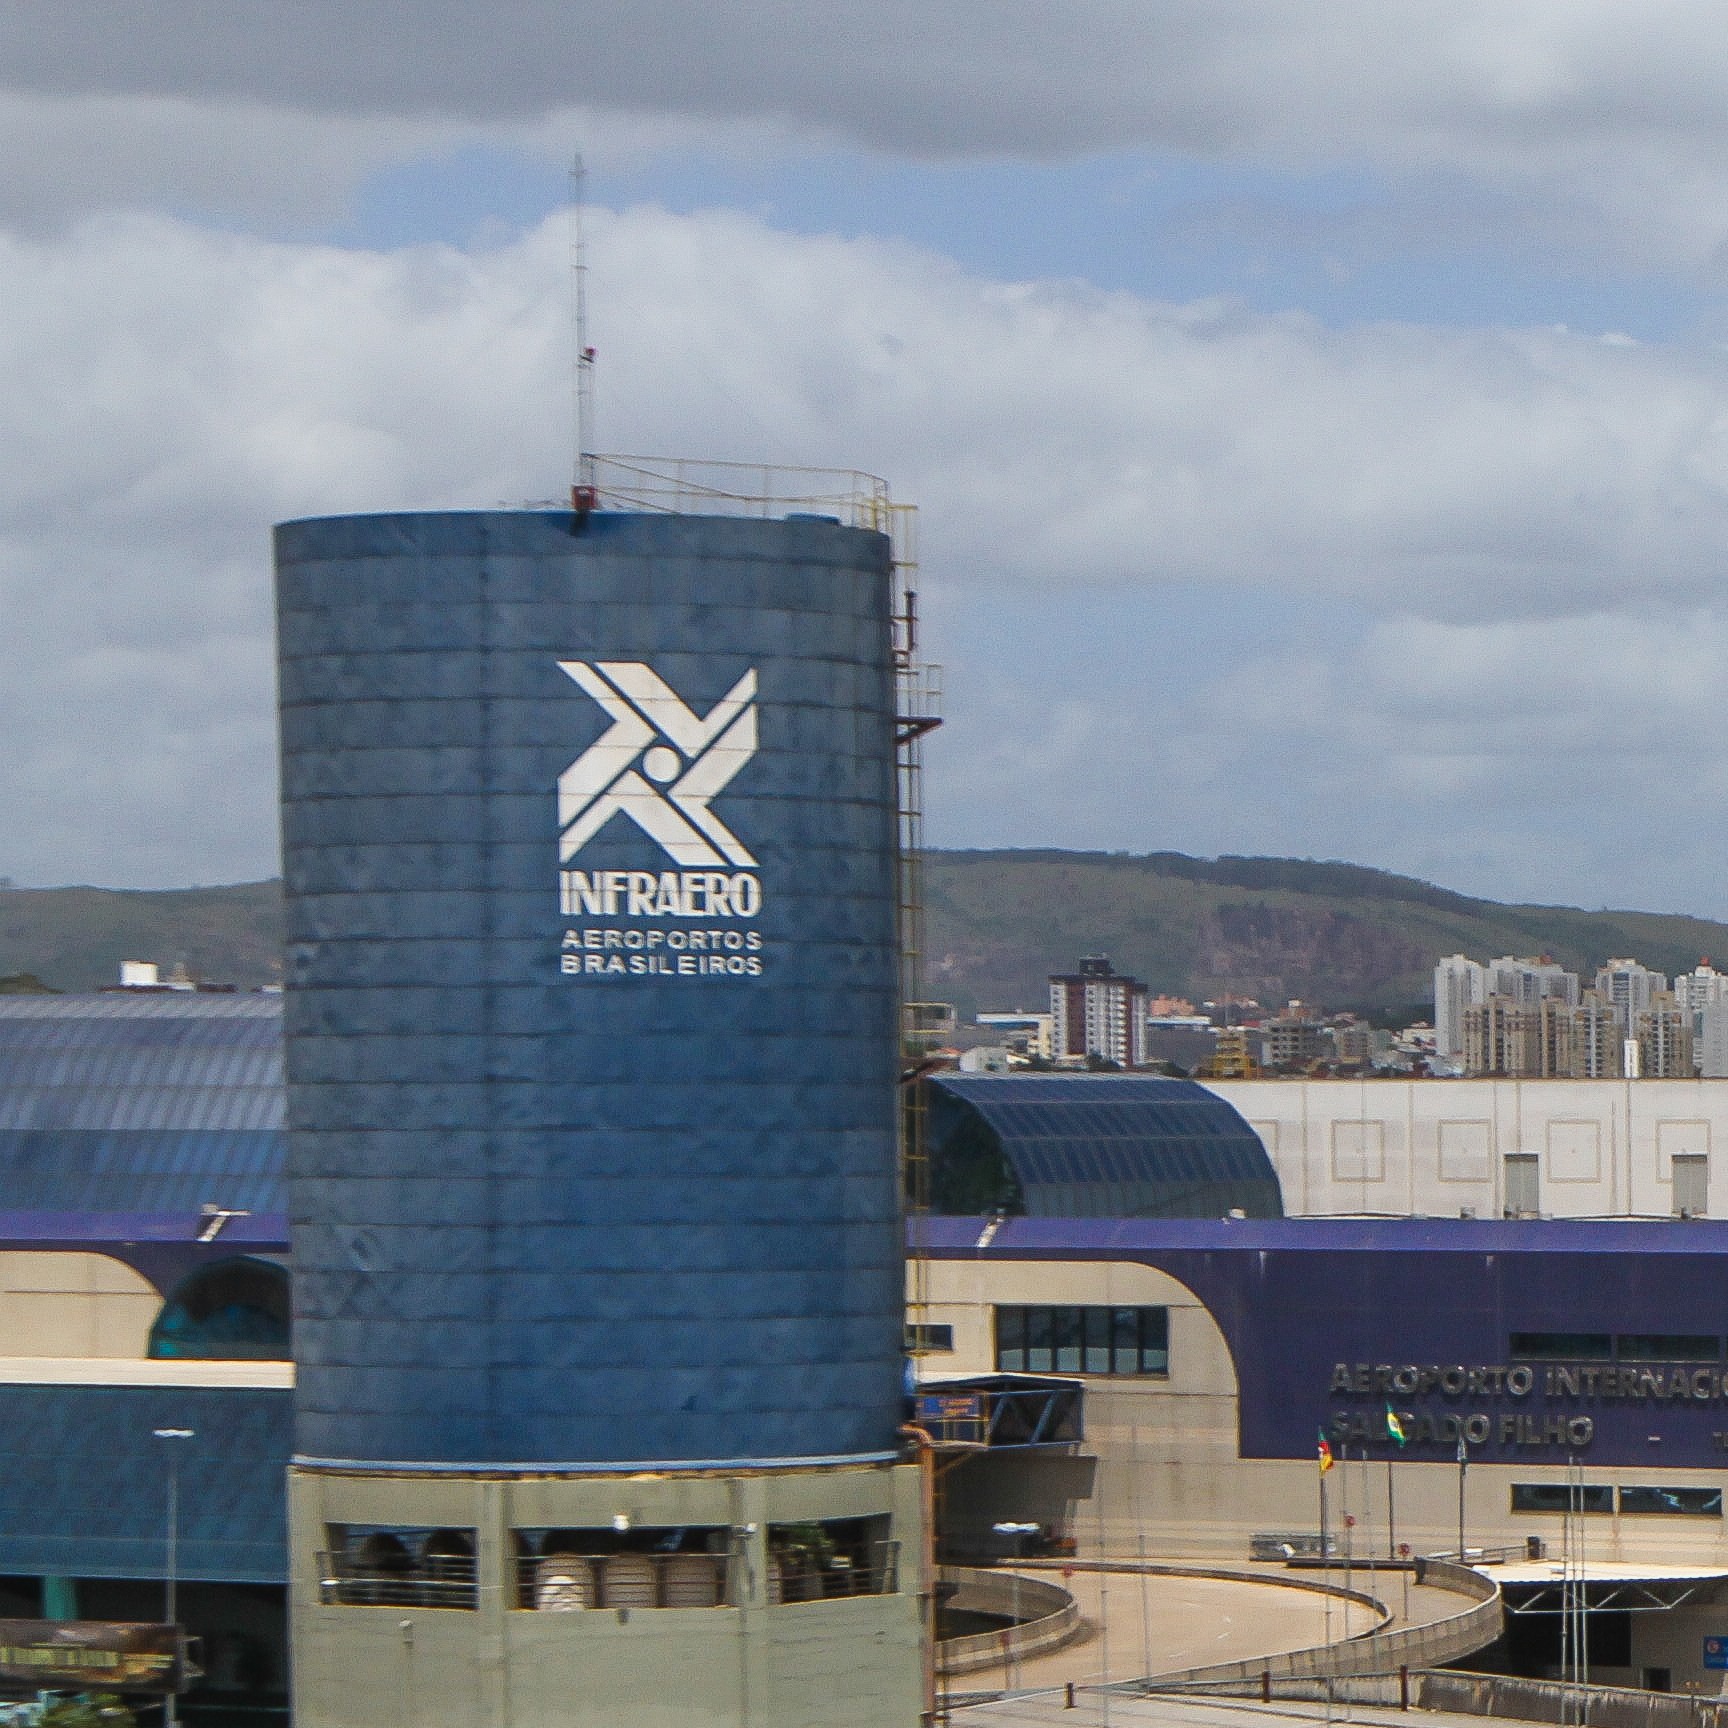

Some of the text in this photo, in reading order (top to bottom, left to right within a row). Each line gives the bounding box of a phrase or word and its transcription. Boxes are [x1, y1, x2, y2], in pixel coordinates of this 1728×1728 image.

[558, 869, 763, 917] INFRAERO
[560, 929, 763, 951] AEROPORTOS
[560, 953, 763, 976] BRASILEIROS
[1329, 1362, 1534, 1396] AEROPORTO
[1500, 1414, 1594, 1446] FILHO
